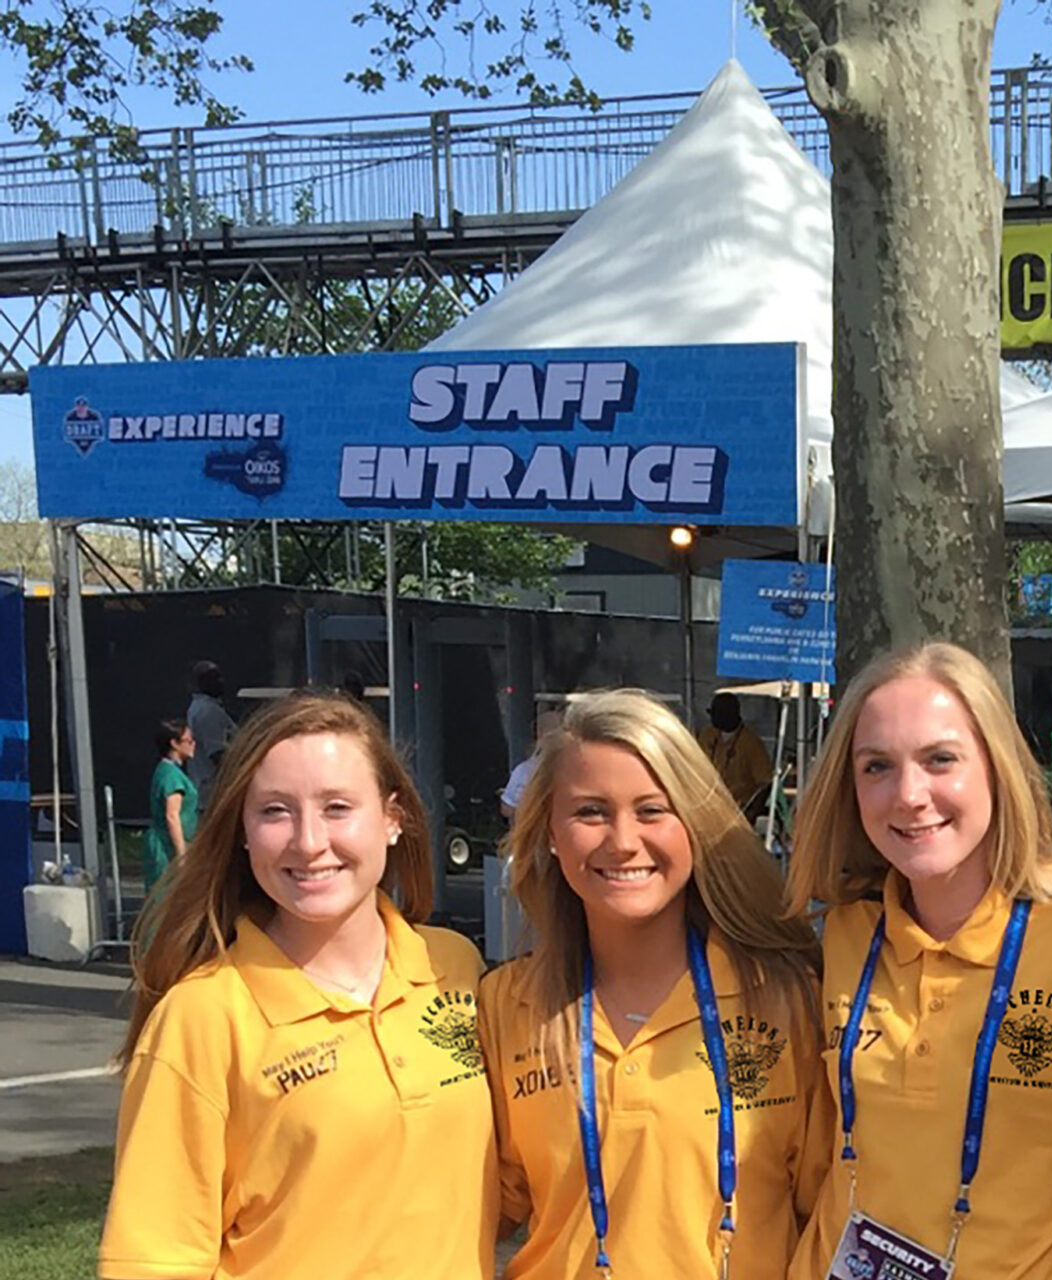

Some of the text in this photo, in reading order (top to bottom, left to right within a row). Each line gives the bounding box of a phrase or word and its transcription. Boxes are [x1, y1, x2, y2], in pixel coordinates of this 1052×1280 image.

[408, 360, 630, 426] STAFF
[107, 413, 281, 441] EXPERIENCE
[338, 445, 722, 506] ENTRANCE
[421, 990, 479, 1026] ECHELO
[721, 1014, 779, 1041] HELON
[860, 1229, 935, 1274] SECURITY
